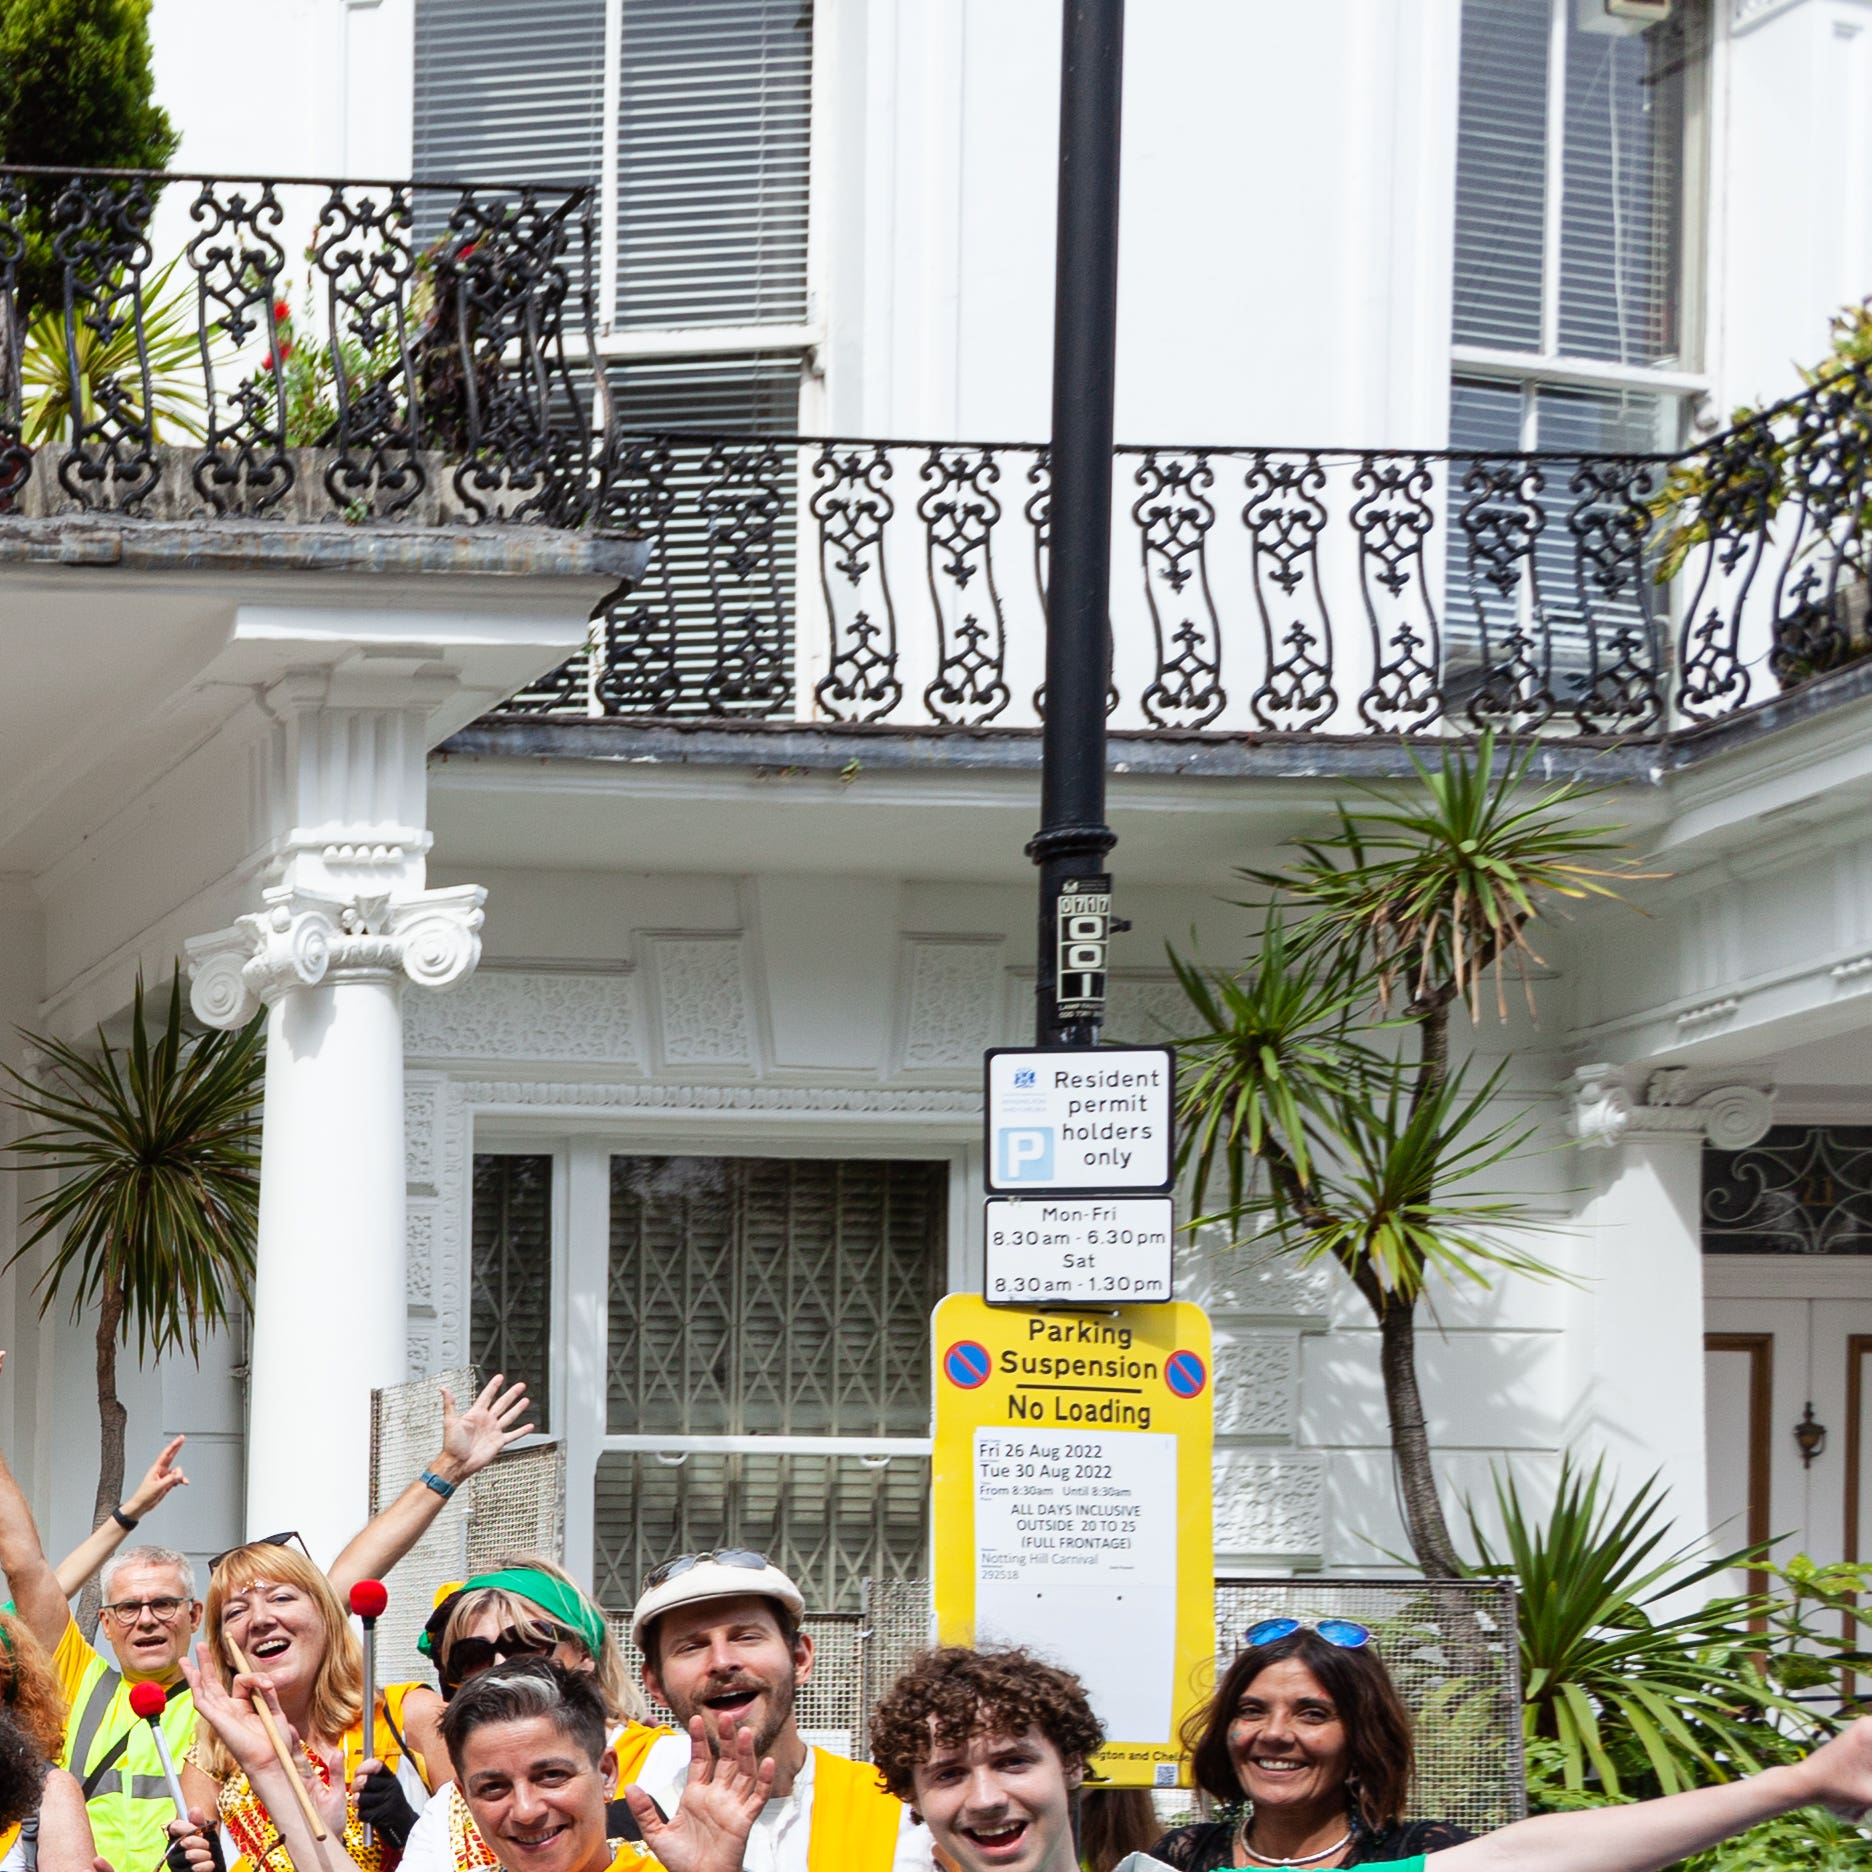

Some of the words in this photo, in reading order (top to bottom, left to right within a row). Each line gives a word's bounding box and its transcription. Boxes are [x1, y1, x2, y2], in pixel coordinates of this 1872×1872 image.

[1055, 1070, 1159, 1088] Resident
[1069, 1095, 1147, 1117] permit
[1063, 1123, 1152, 1140] holders
[1007, 1131, 1045, 1178] P
[1084, 1148, 1132, 1169] only
[1043, 1207, 1116, 1221] Mon-Fri
[1063, 1254, 1095, 1268] Sat
[1030, 1319, 1132, 1350] Parking
[1000, 1349, 1157, 1379] Suspension
[1008, 1395, 1043, 1420] No
[1056, 1396, 1150, 1429] Loading
[980, 1444, 999, 1456] Fri
[1005, 1444, 1024, 1457] 26
[1029, 1445, 1060, 1461] Aug
[1065, 1445, 1102, 1458] 2022
[980, 1464, 1010, 1477] Tue
[1016, 1464, 1034, 1477] 30
[1040, 1465, 1070, 1481] Aug
[1075, 1465, 1112, 1478] 2022
[980, 1485, 1009, 1495] From
[1063, 1487, 1089, 1496] Until
[1011, 1504, 1033, 1515] ALL
[1038, 1504, 1072, 1515] DAYS
[1076, 1505, 1140, 1516] INCLUSIVE
[1017, 1520, 1073, 1531] OUTSIDE
[1081, 1520, 1096, 1531] 20
[1100, 1521, 1117, 1532] TO
[1121, 1521, 1136, 1532] 25
[981, 1553, 1027, 1566] Notting
[1030, 1553, 1048, 1563] Hill
[1051, 1553, 1098, 1565] Carnival
[1128, 1751, 1149, 1761] and
